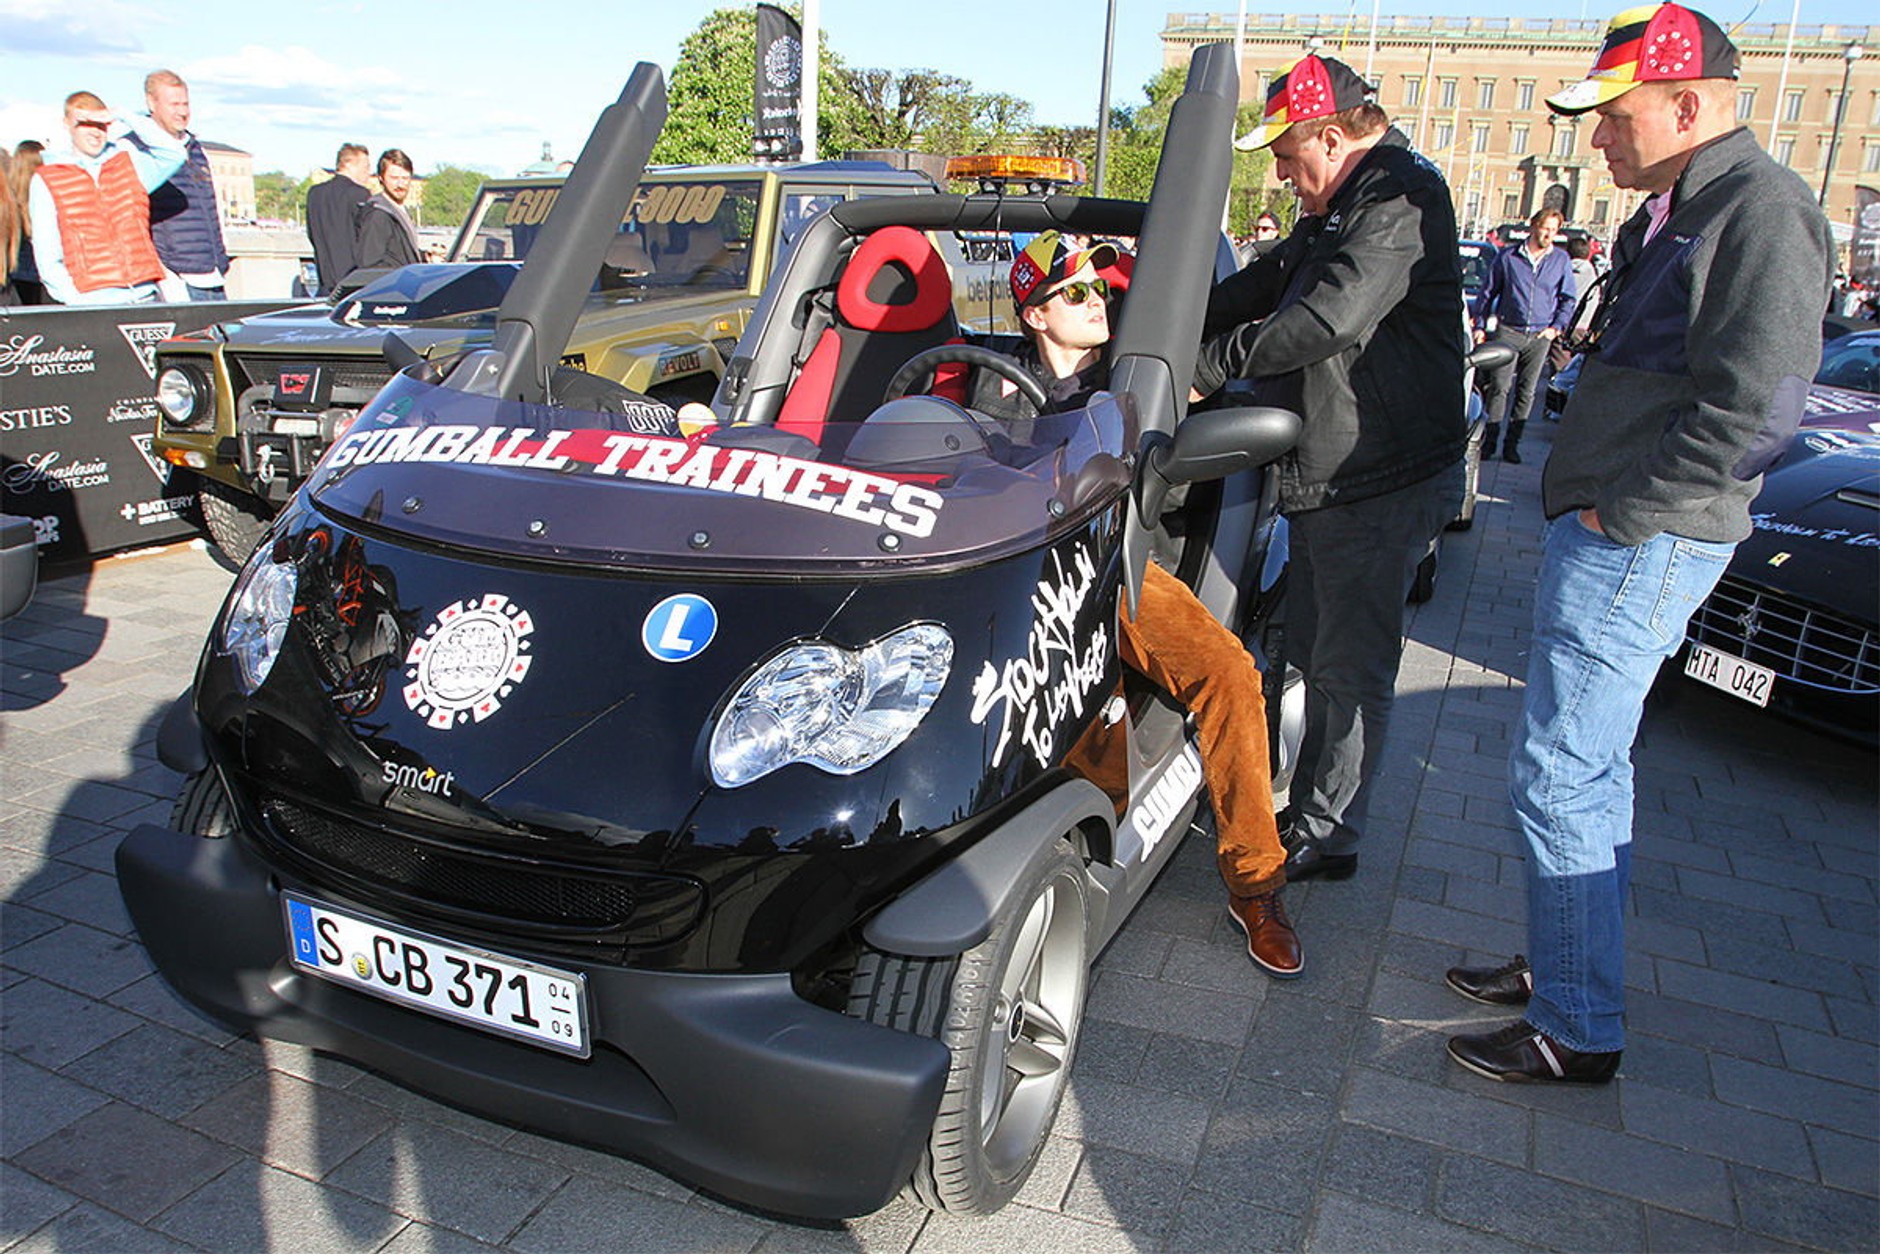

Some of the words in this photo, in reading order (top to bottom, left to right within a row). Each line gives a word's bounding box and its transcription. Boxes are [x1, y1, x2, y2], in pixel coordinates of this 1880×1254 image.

[0, 335, 94, 376] Anastasia
[32, 362, 95, 376] DATE.COM
[3, 451, 107, 494] Anastasia
[48, 474, 109, 492] DATE.COM
[326, 425, 571, 470] GUMBALL
[593, 434, 944, 538] TRAINEES
[138, 496, 194, 515] BATTERY
[659, 603, 693, 651] L
[1731, 665, 1768, 701] 042
[382, 761, 454, 797] smart
[300, 938, 311, 953] D
[316, 916, 344, 966] S
[373, 935, 433, 996] CB
[444, 955, 540, 1028] 371
[548, 983, 570, 1000] 04
[552, 1020, 573, 1037] 09
